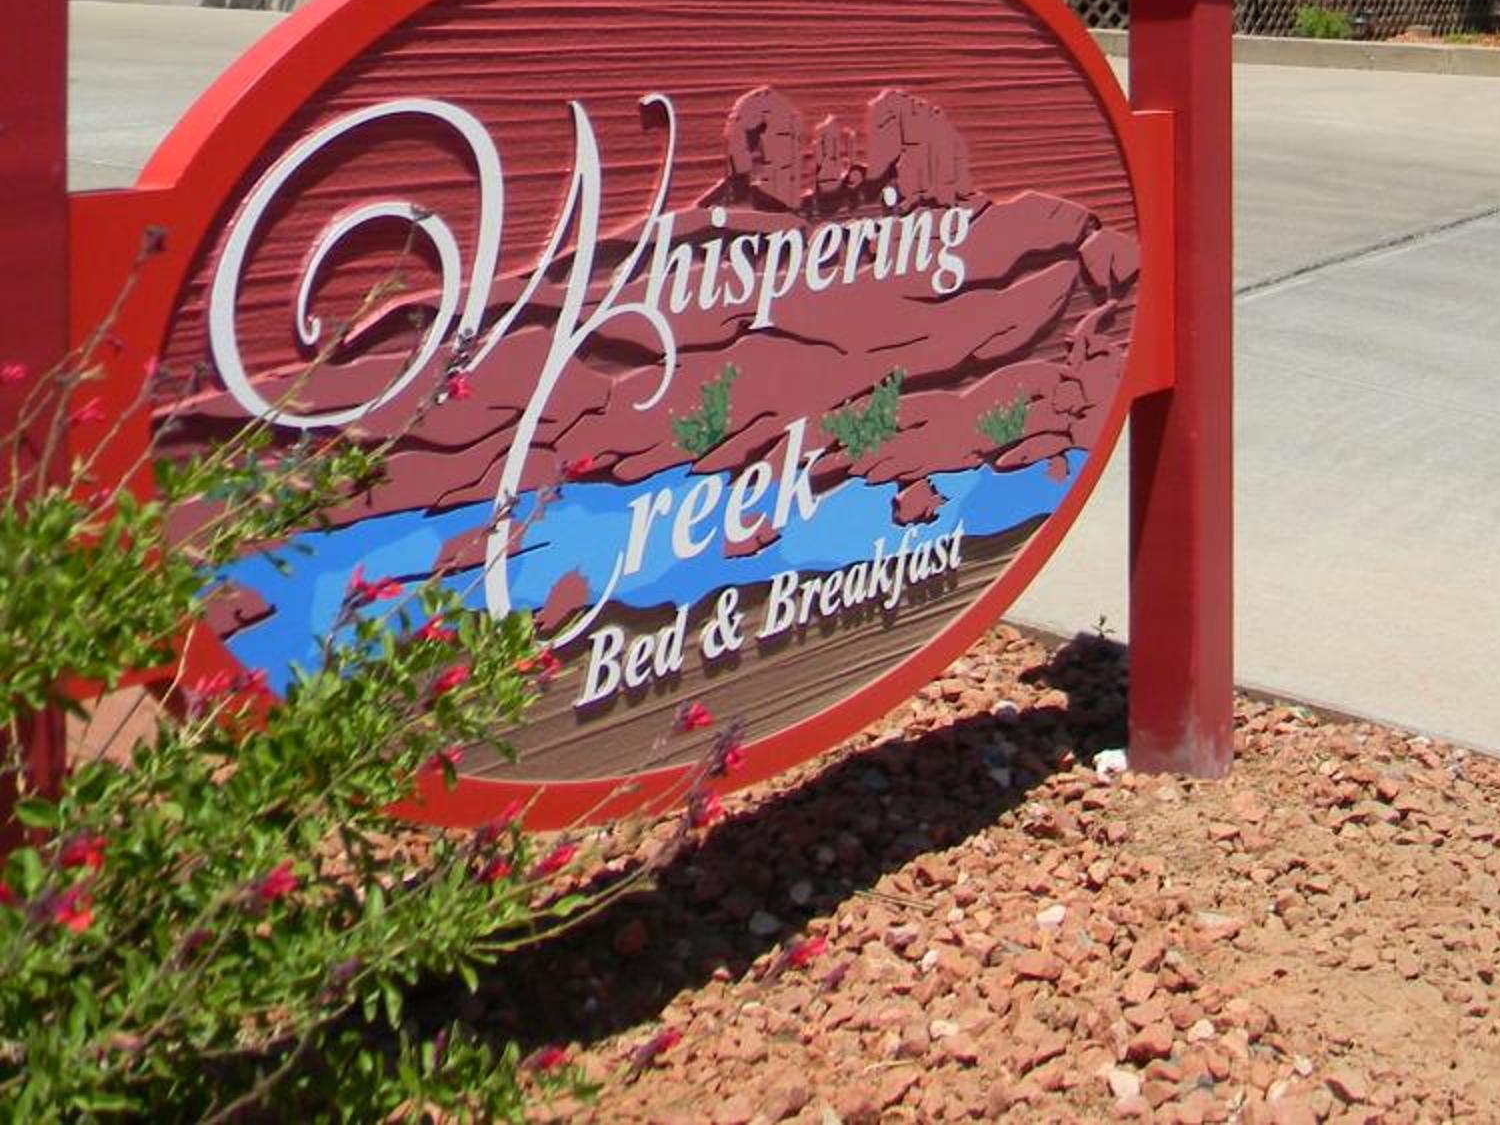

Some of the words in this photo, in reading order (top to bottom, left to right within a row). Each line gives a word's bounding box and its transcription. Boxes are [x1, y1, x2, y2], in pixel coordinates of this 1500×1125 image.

[208, 93, 973, 428] Whispering
[575, 602, 689, 707] Bed
[701, 587, 746, 659] &
[755, 518, 965, 638] Breakfast
